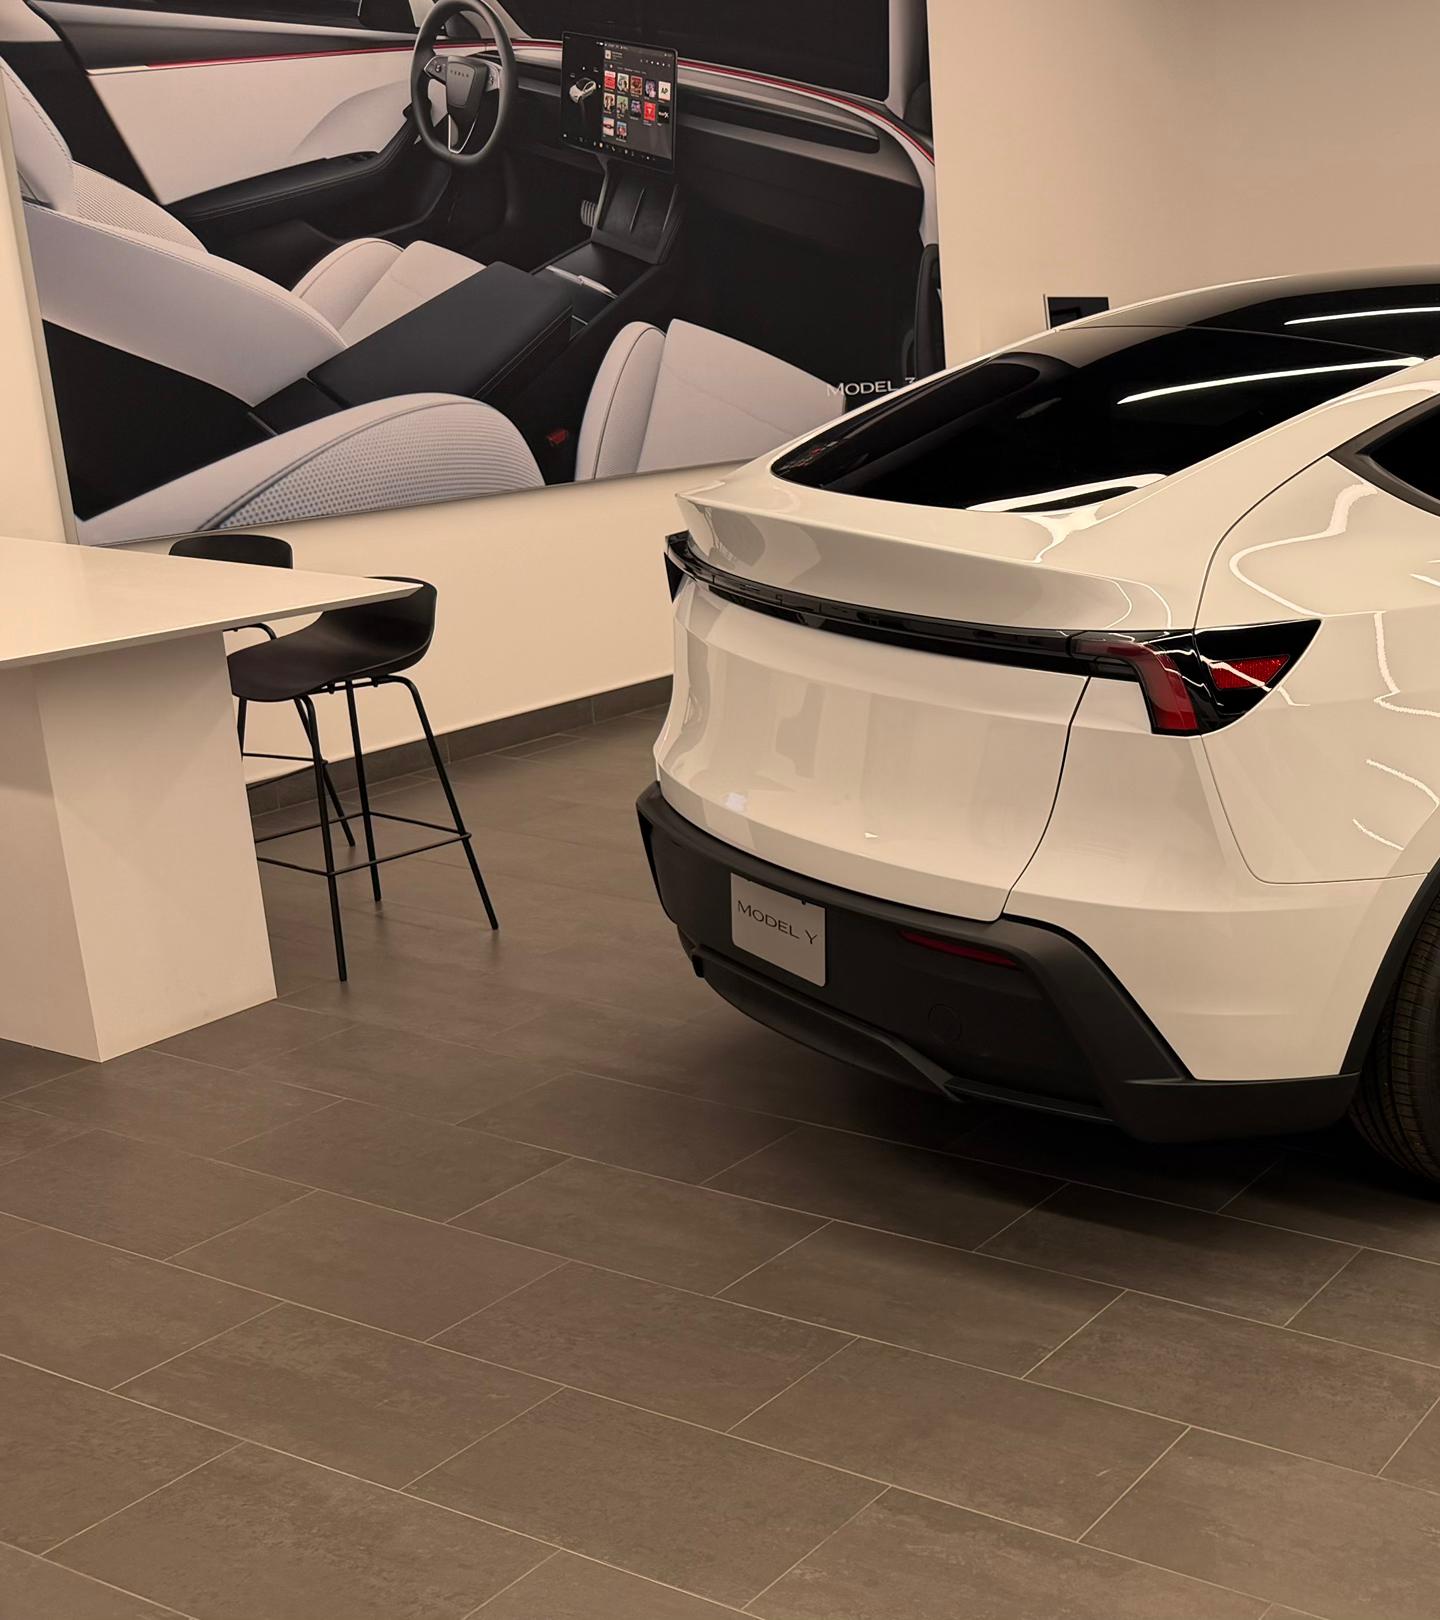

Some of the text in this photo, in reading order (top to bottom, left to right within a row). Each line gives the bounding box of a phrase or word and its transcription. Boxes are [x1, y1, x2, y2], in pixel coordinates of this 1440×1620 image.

[826, 380, 898, 396] MODEL
[737, 900, 818, 945] MODEL Y
